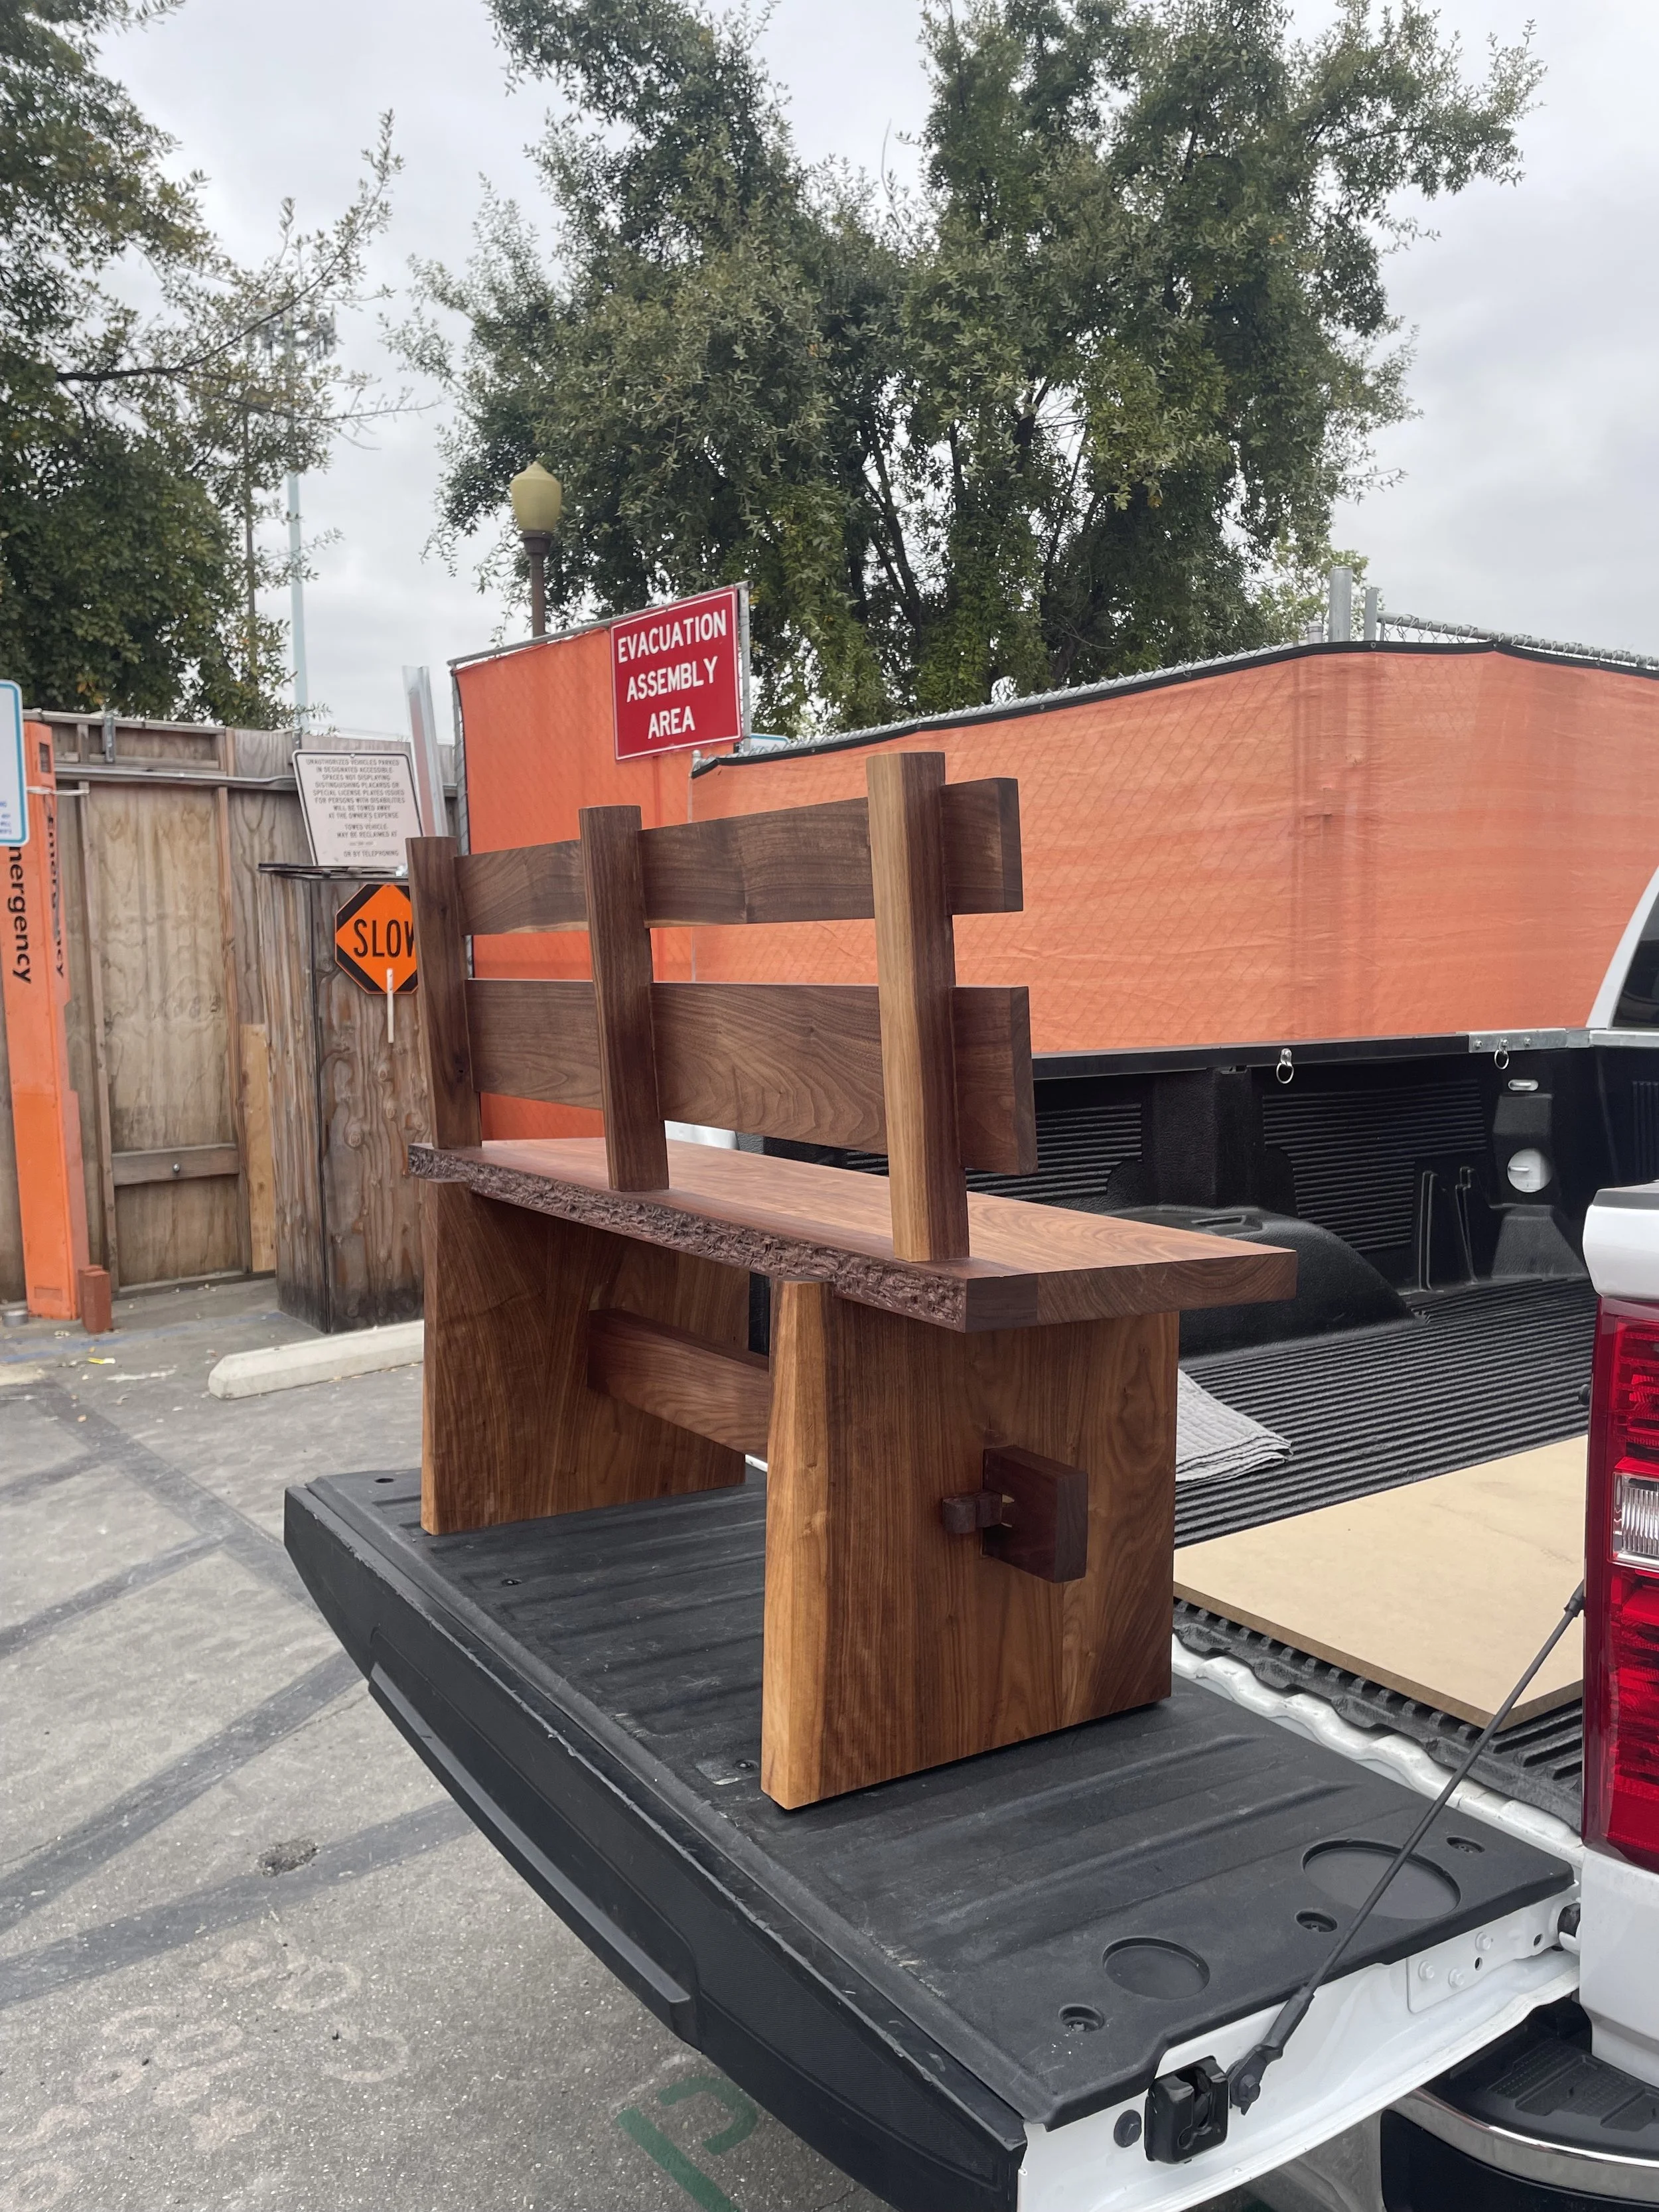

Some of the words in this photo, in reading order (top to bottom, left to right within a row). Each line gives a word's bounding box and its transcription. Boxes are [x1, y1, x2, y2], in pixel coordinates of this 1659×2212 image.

[618, 609, 727, 664] EVACUATION
[626, 656, 718, 703] ASSEMBLY
[648, 705, 695, 739] AREA
[8, 846, 31, 984] mergency
